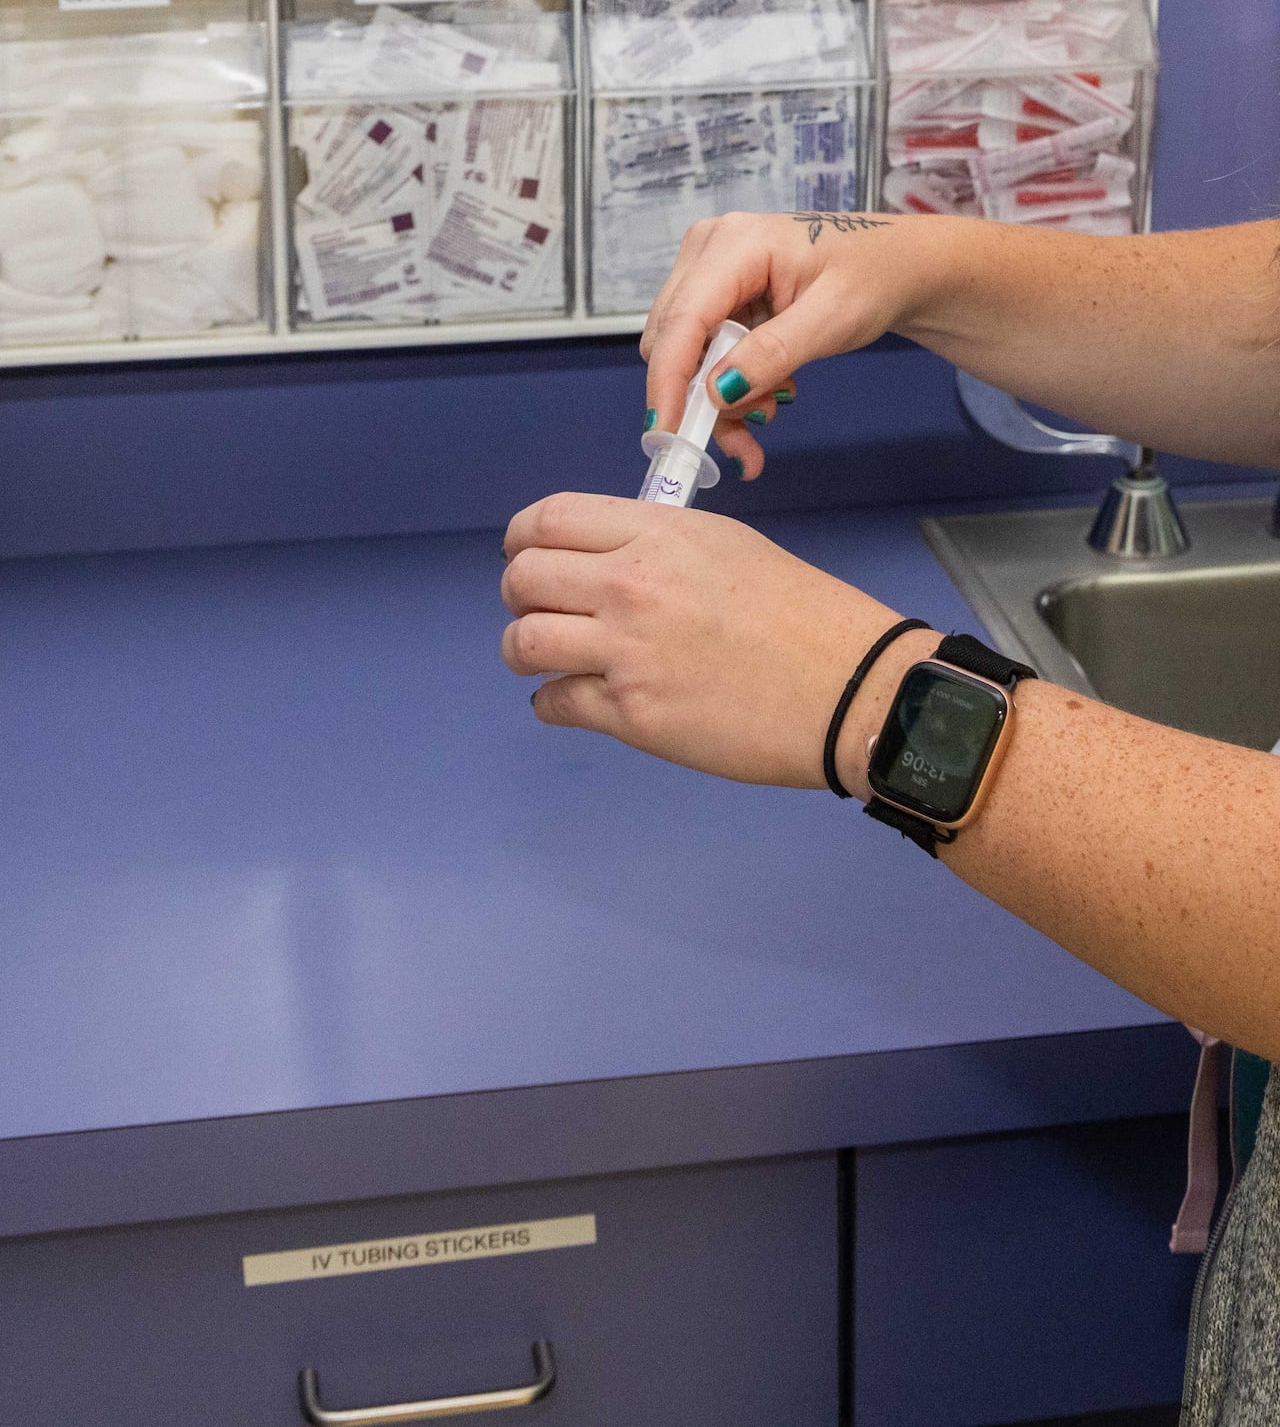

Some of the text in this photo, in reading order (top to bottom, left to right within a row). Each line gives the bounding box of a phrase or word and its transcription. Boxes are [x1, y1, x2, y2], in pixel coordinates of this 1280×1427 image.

[902, 751, 947, 782] 13:06
[311, 1227, 531, 1271] IV TUBING STICKERS
